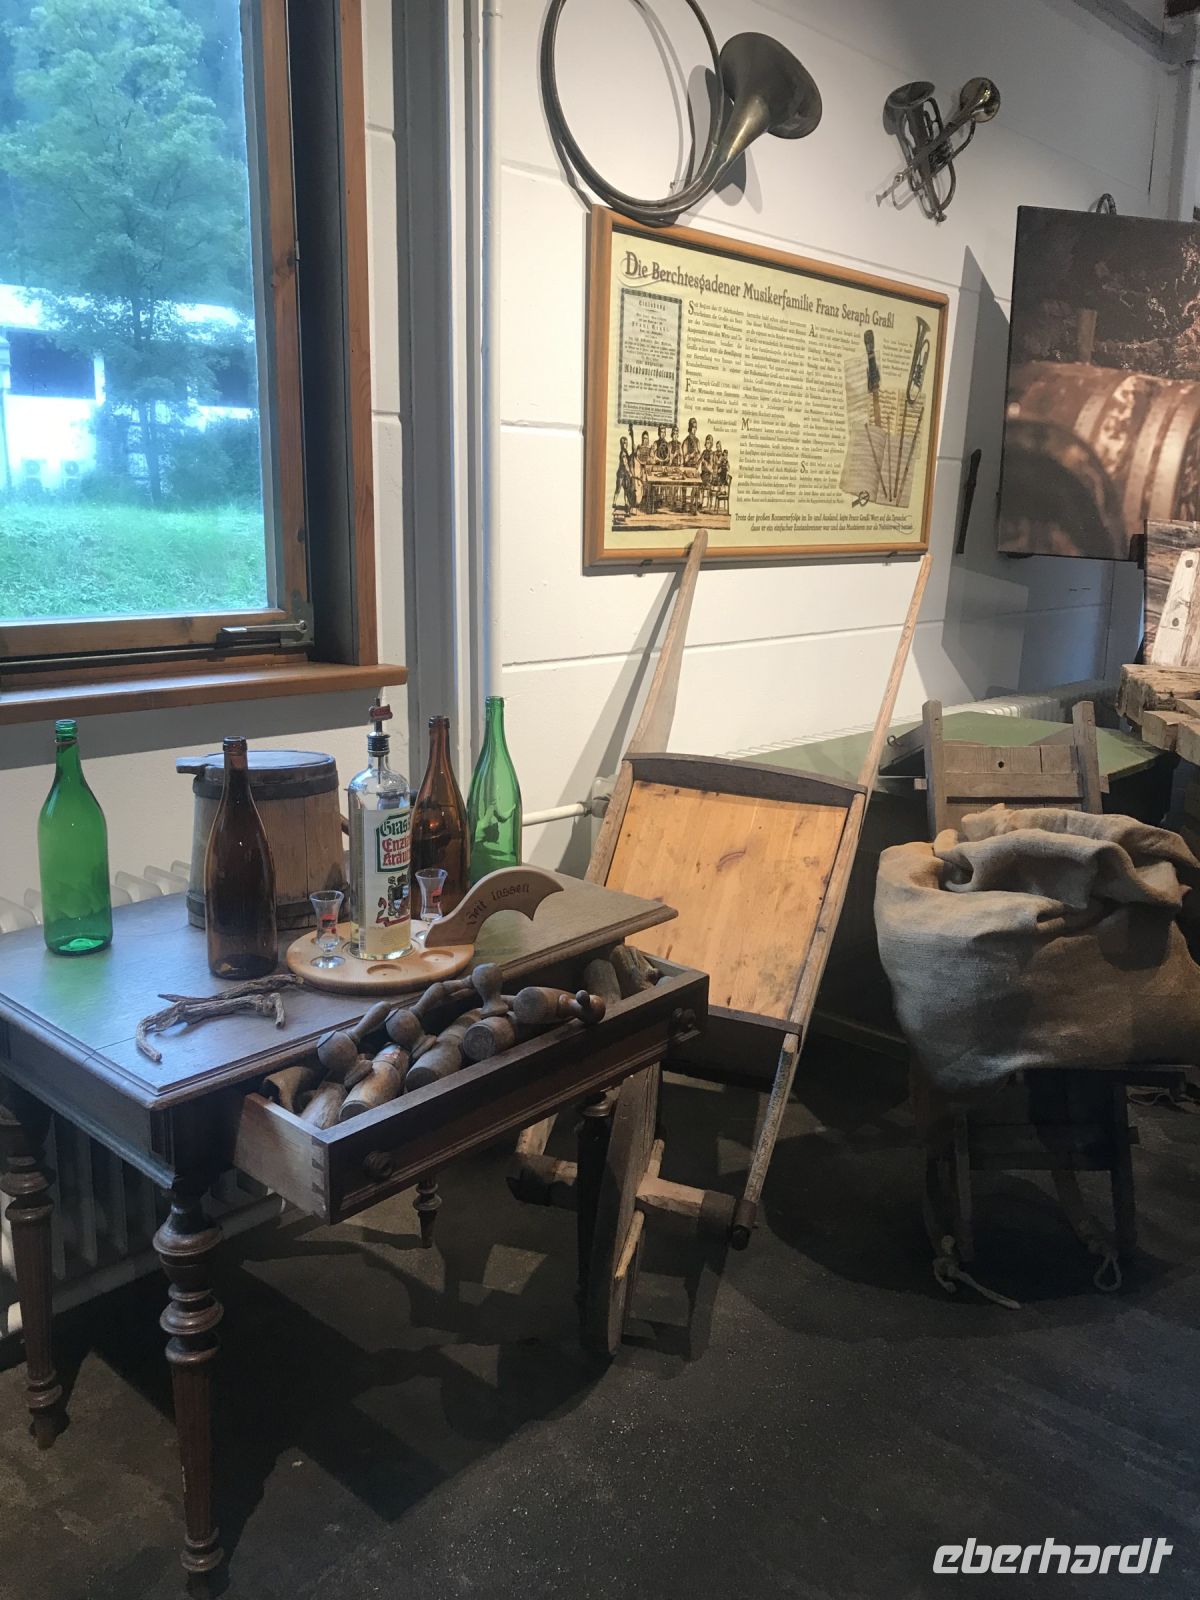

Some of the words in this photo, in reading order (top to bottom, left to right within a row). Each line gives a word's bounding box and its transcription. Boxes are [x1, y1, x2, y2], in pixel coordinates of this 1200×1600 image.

[624, 250, 648, 278] Die
[651, 261, 741, 295] Berchtesgadener
[743, 281, 814, 311] Musikerfamilie
[815, 298, 840, 319] Franz
[842, 303, 870, 326] Seraph
[872, 310, 895, 329] Graßl
